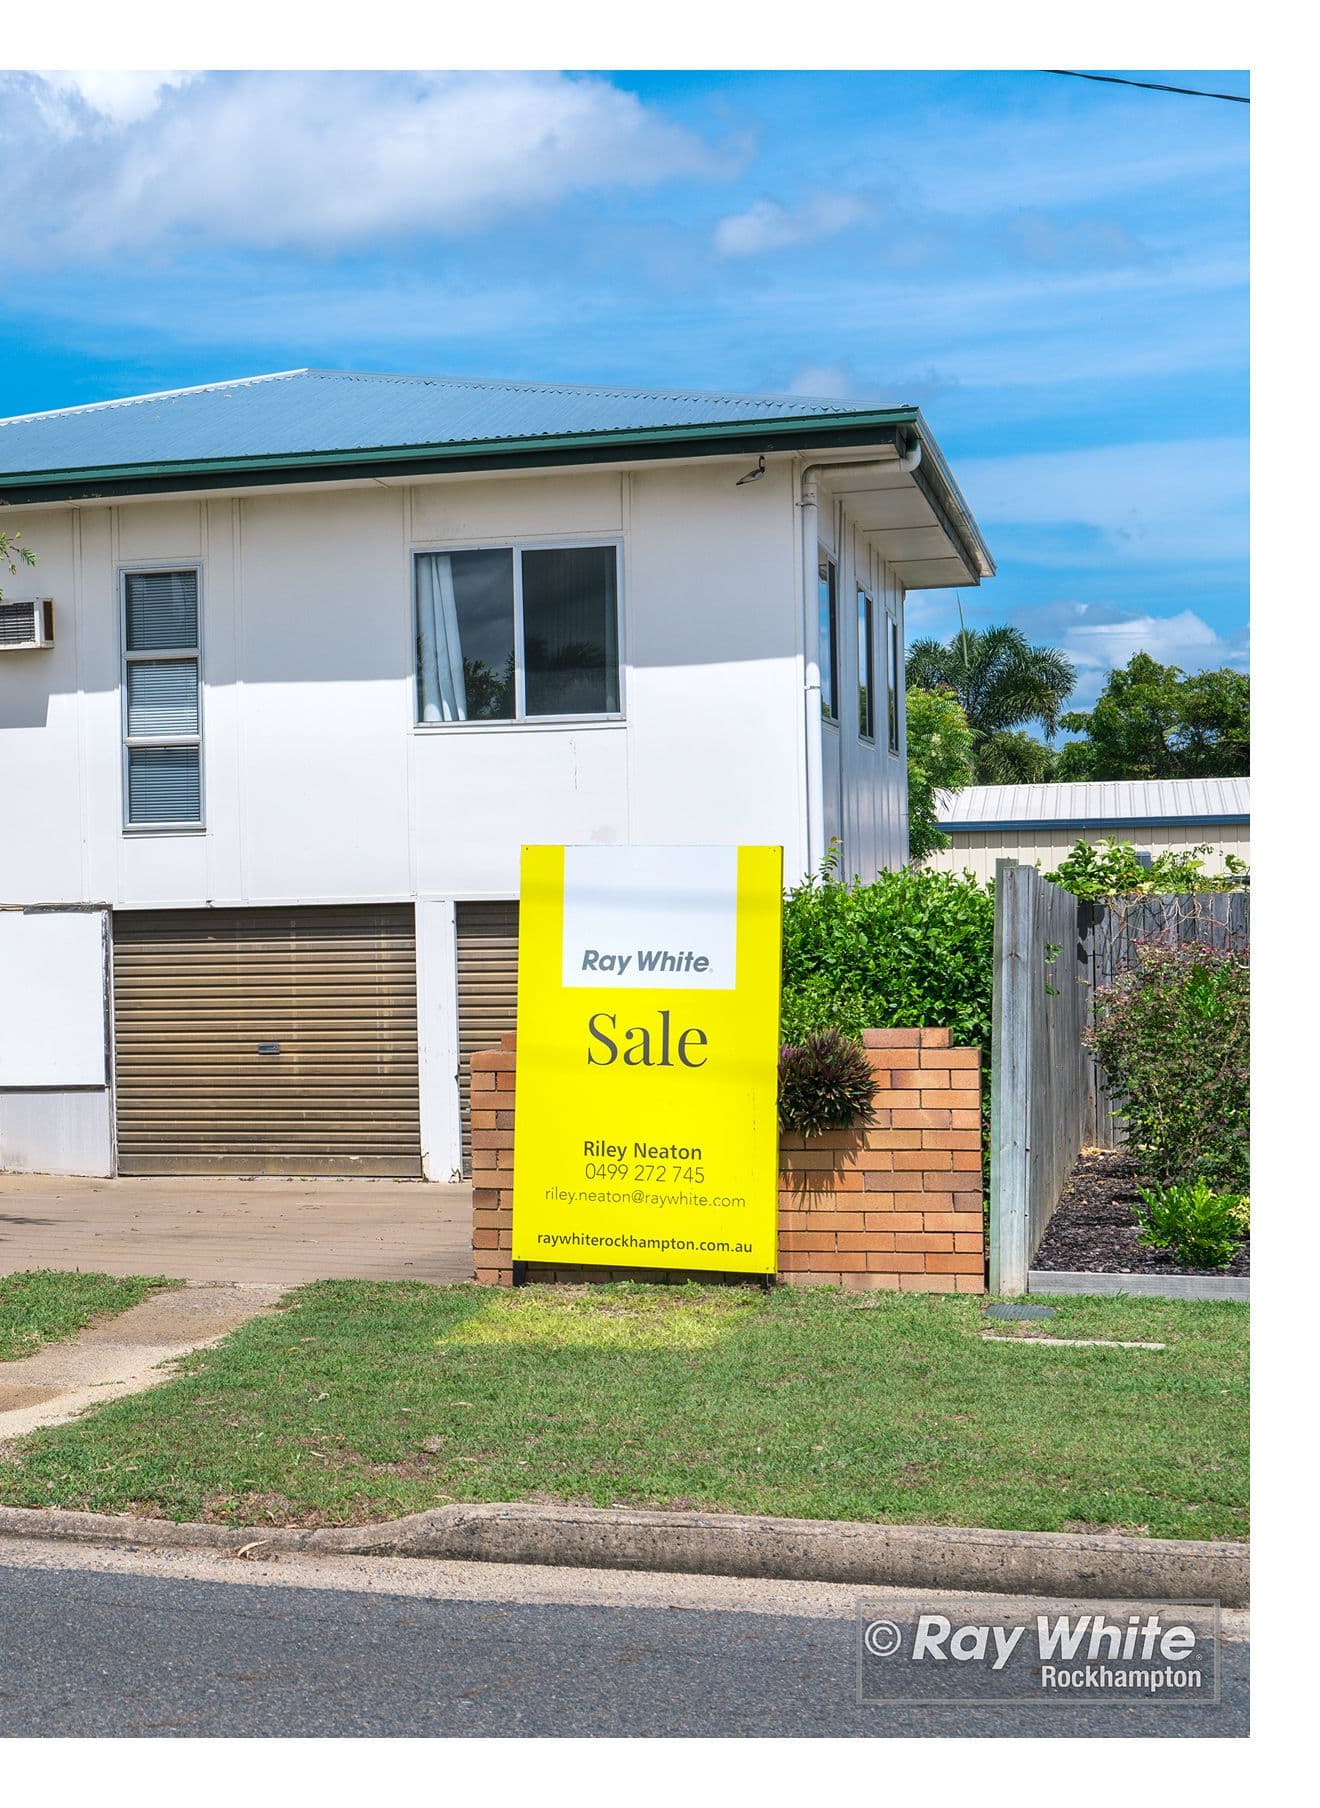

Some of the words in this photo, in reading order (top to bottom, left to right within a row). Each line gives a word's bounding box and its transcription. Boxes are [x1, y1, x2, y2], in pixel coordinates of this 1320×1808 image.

[581, 949, 633, 975] Ray
[636, 950, 710, 973] White
[587, 1009, 708, 1068] Sale
[583, 1140, 628, 1162] Riley
[633, 1142, 702, 1161] Neaton
[584, 1163, 629, 1180] 0499
[634, 1165, 667, 1182] 272
[672, 1166, 706, 1184] 745
[545, 1187, 746, 1208] riley.neaton@raywhite.com
[537, 1233, 753, 1253] raywhiterockhampton.com.au
